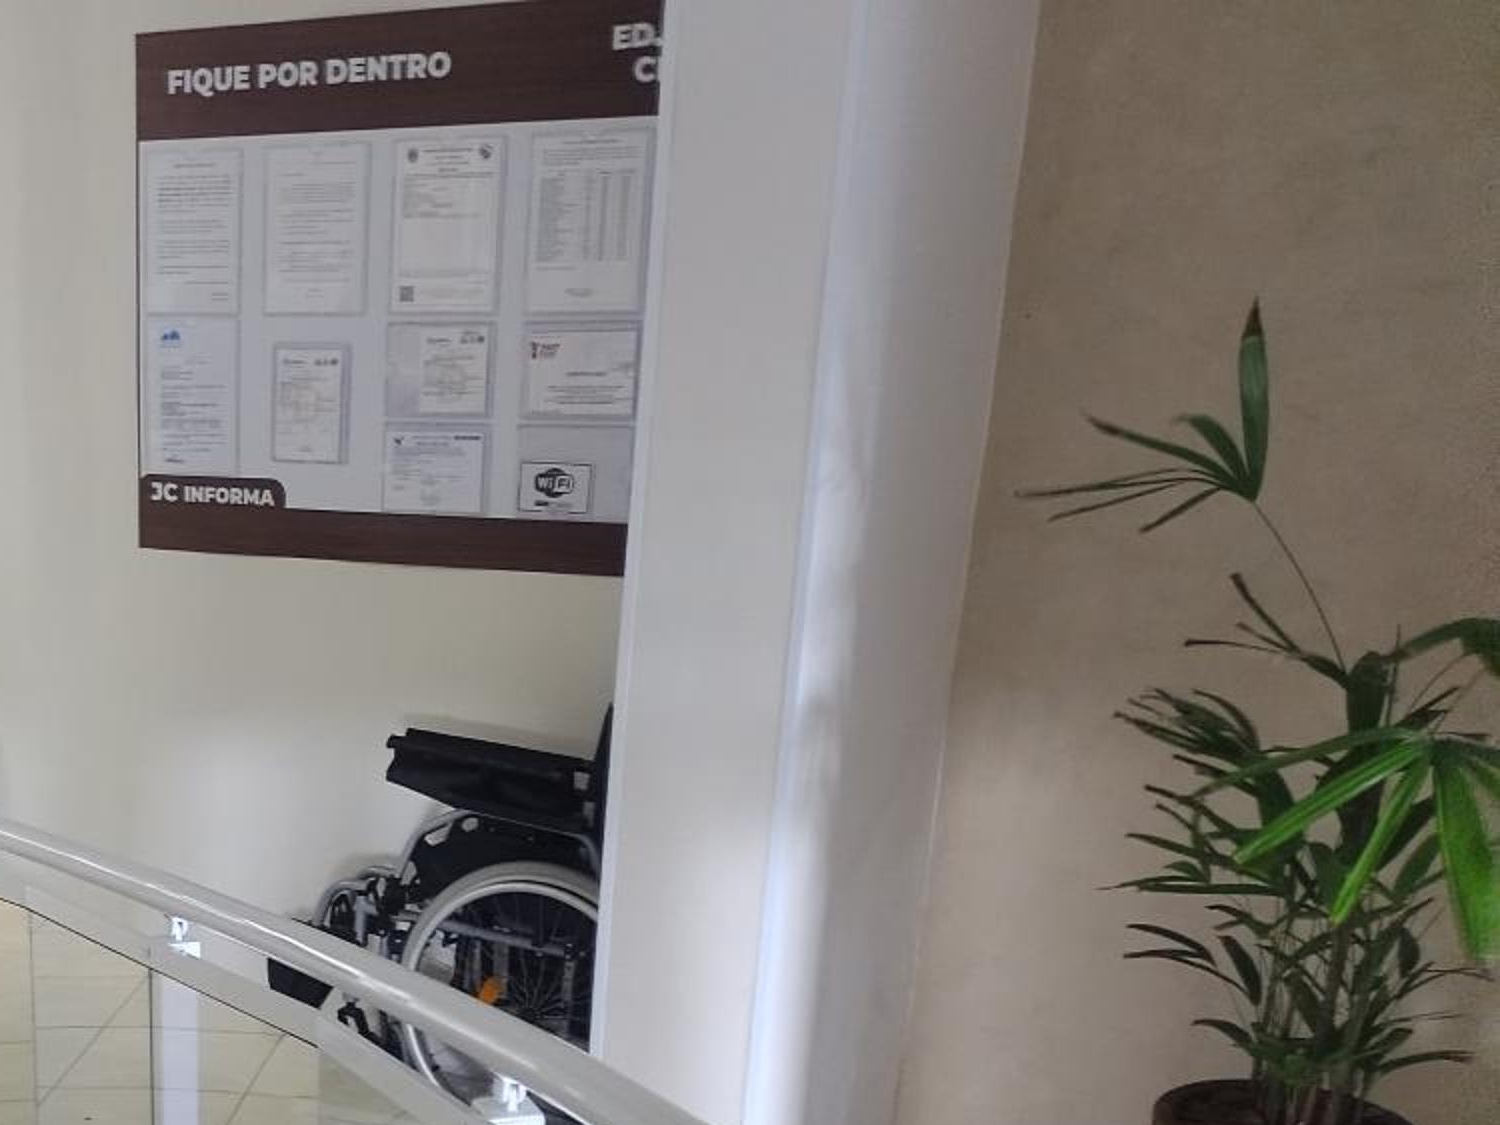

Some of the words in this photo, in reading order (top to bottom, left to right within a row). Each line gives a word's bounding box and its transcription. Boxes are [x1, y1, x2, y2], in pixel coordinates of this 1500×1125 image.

[167, 65, 251, 96] FIQUE
[258, 60, 318, 88] POR
[325, 51, 451, 85] DENTRO
[184, 485, 275, 507] INFORMA
